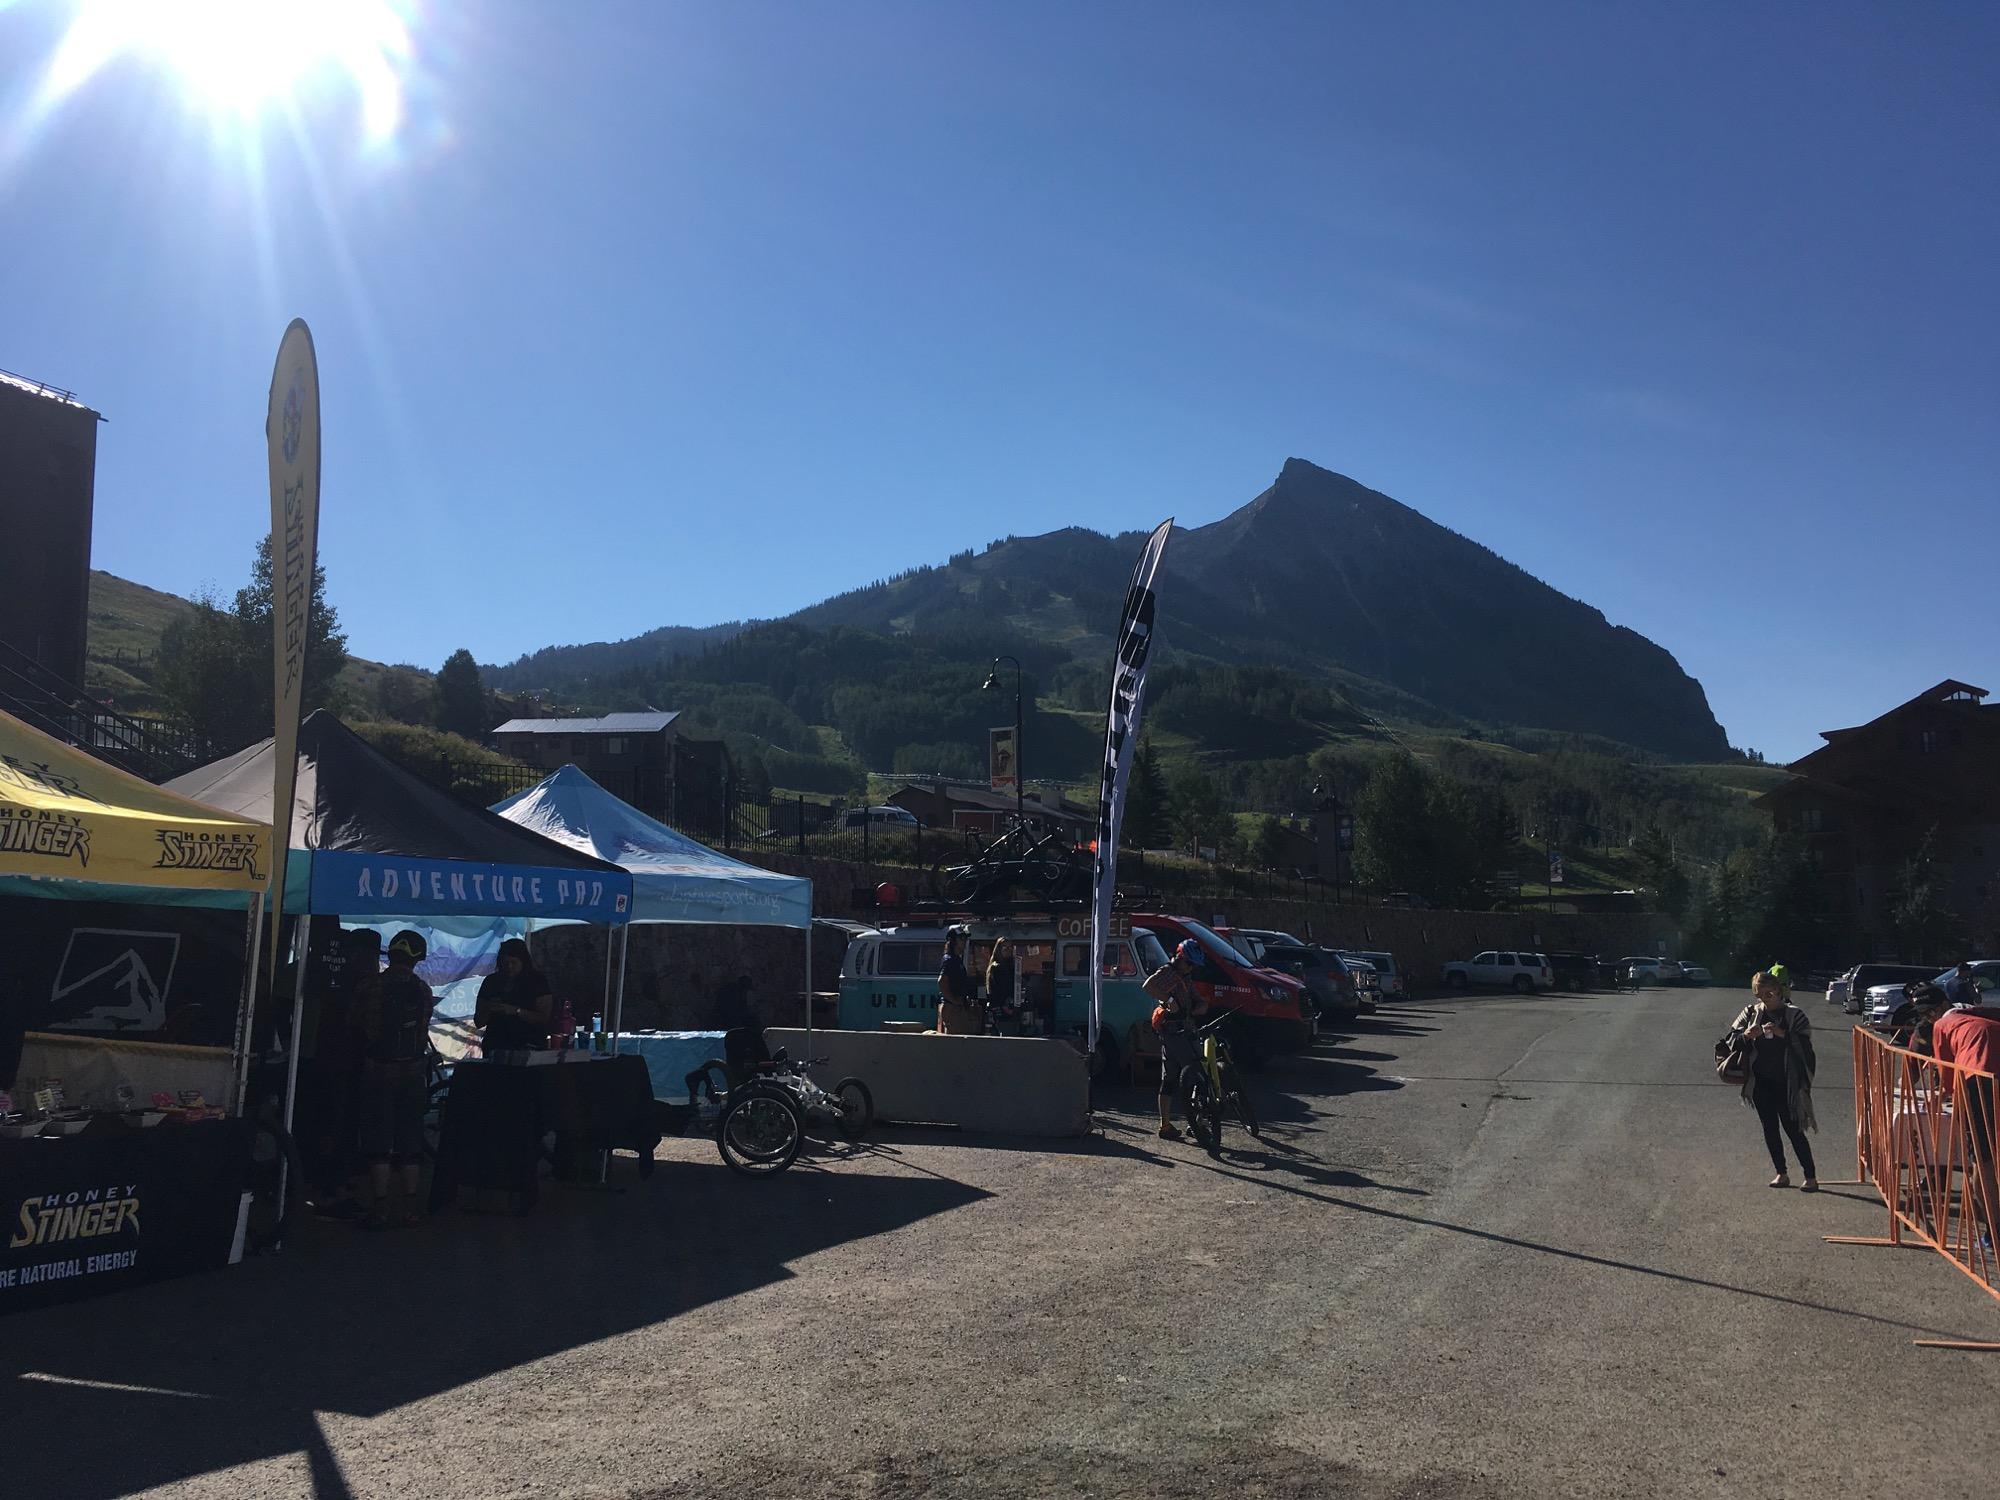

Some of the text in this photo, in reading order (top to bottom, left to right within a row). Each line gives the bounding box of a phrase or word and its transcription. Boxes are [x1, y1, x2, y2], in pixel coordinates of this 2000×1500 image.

[0, 808, 81, 826] HONEY
[184, 832, 257, 843] HONEY
[153, 829, 259, 880] STINGER
[357, 867, 544, 904] ADVENTURE
[1058, 917, 1129, 936] COFEE
[45, 1184, 137, 1207] HONEY
[9, 1196, 141, 1249] STINGER
[20, 1258, 84, 1285] NATURAL
[87, 1249, 138, 1274] ENERGY
